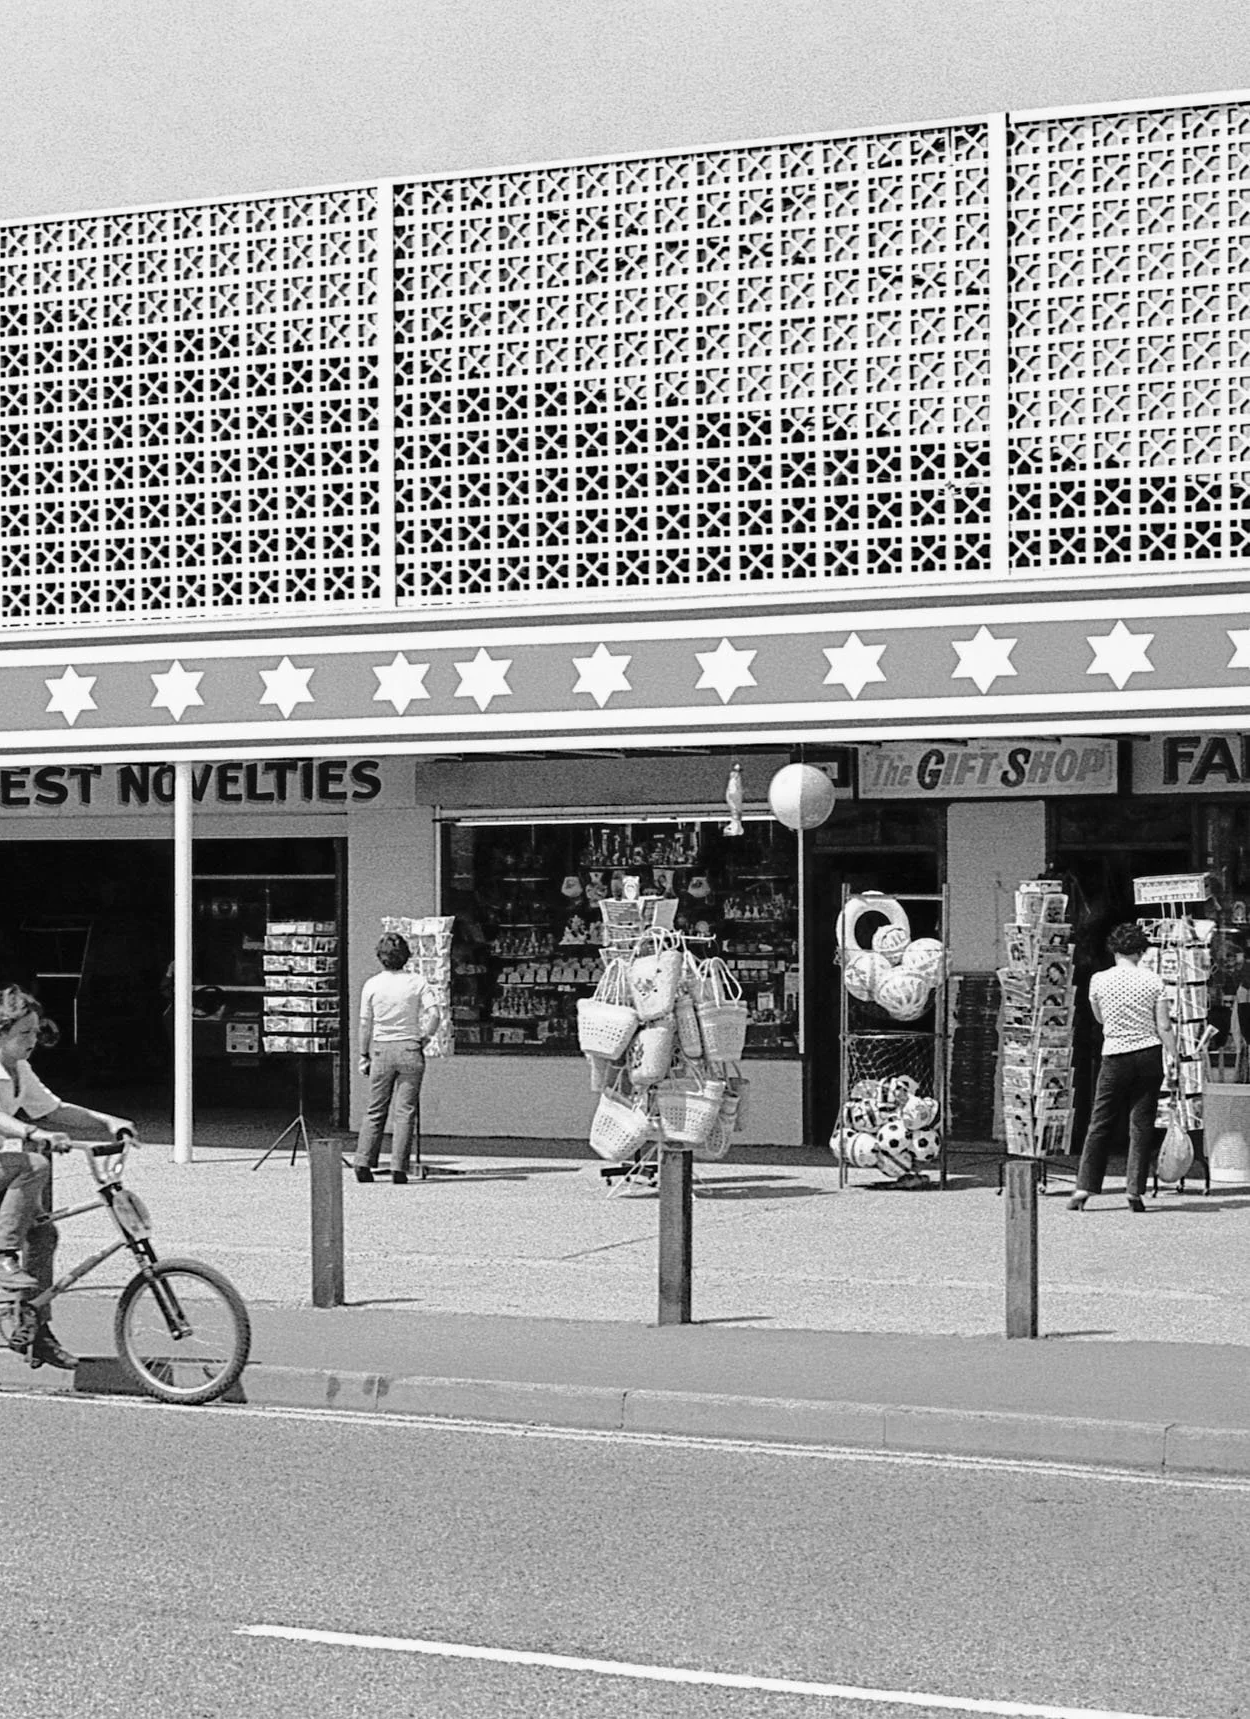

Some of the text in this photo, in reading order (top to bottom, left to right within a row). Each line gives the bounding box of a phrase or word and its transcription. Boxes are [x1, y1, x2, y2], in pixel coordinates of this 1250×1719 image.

[116, 759, 383, 806] NOVELTIES
[872, 747, 1105, 791] The GIFT SHOP
